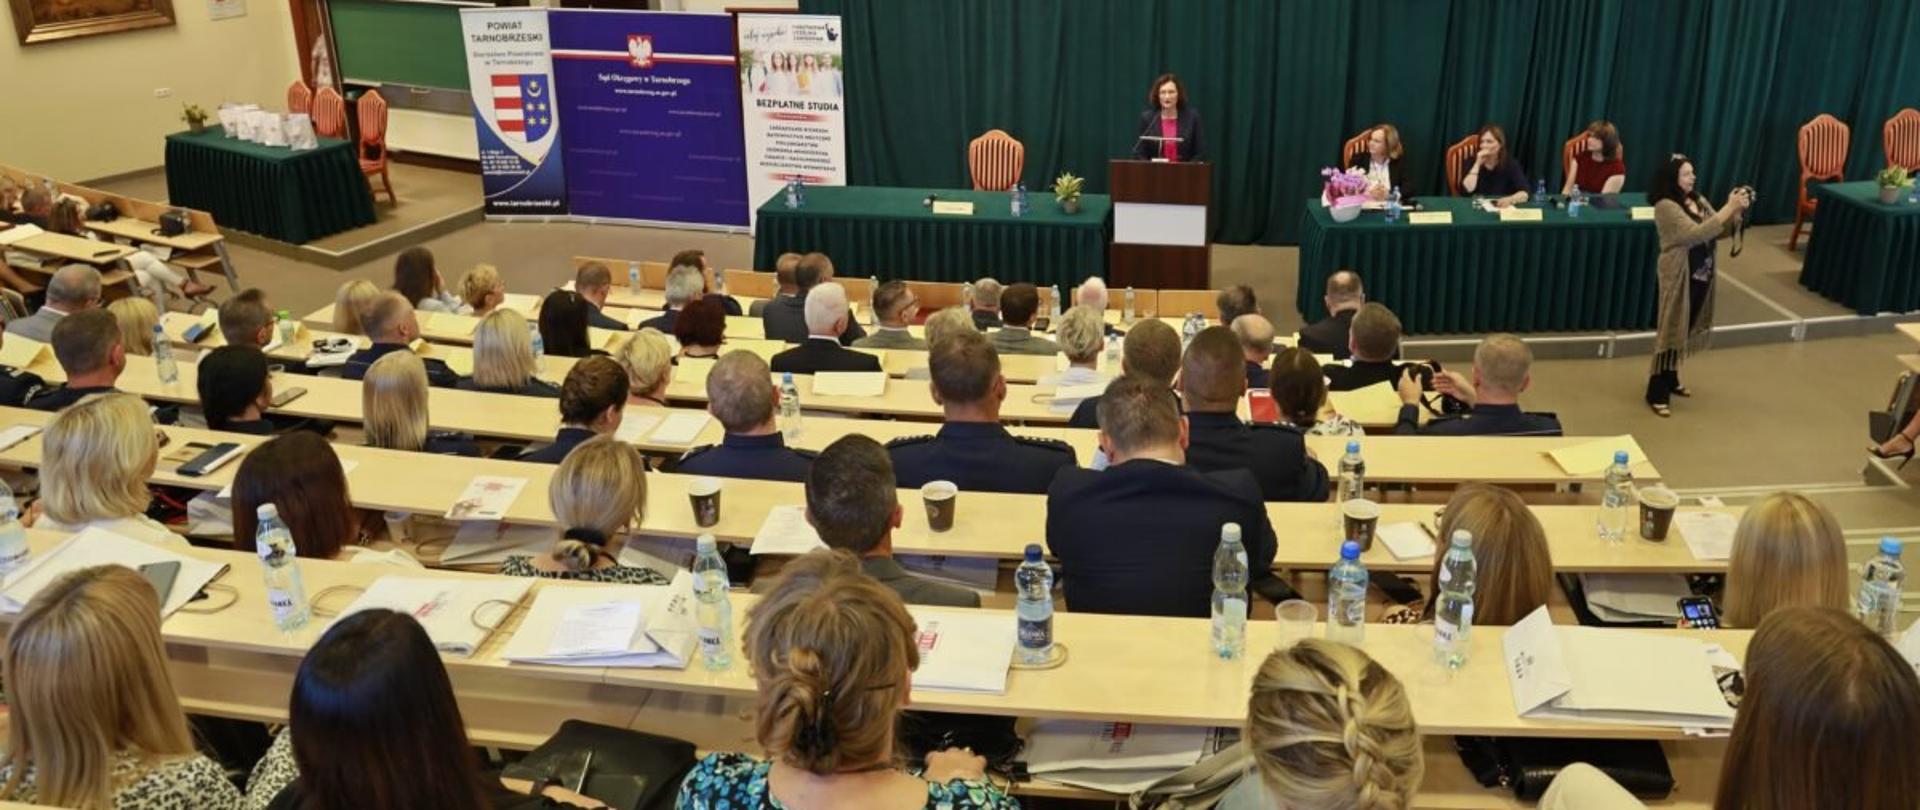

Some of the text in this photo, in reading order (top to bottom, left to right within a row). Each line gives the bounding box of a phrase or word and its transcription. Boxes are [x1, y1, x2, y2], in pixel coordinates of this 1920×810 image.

[487, 22, 522, 30] POWIAT
[471, 33, 543, 42] TARNOBRZESKI
[598, 73, 610, 83] Sąd
[611, 73, 642, 84] Okręgowy
[651, 75, 691, 86] Tarnobrzegu
[756, 98, 840, 111] BEZPŁATNE STUDIA
